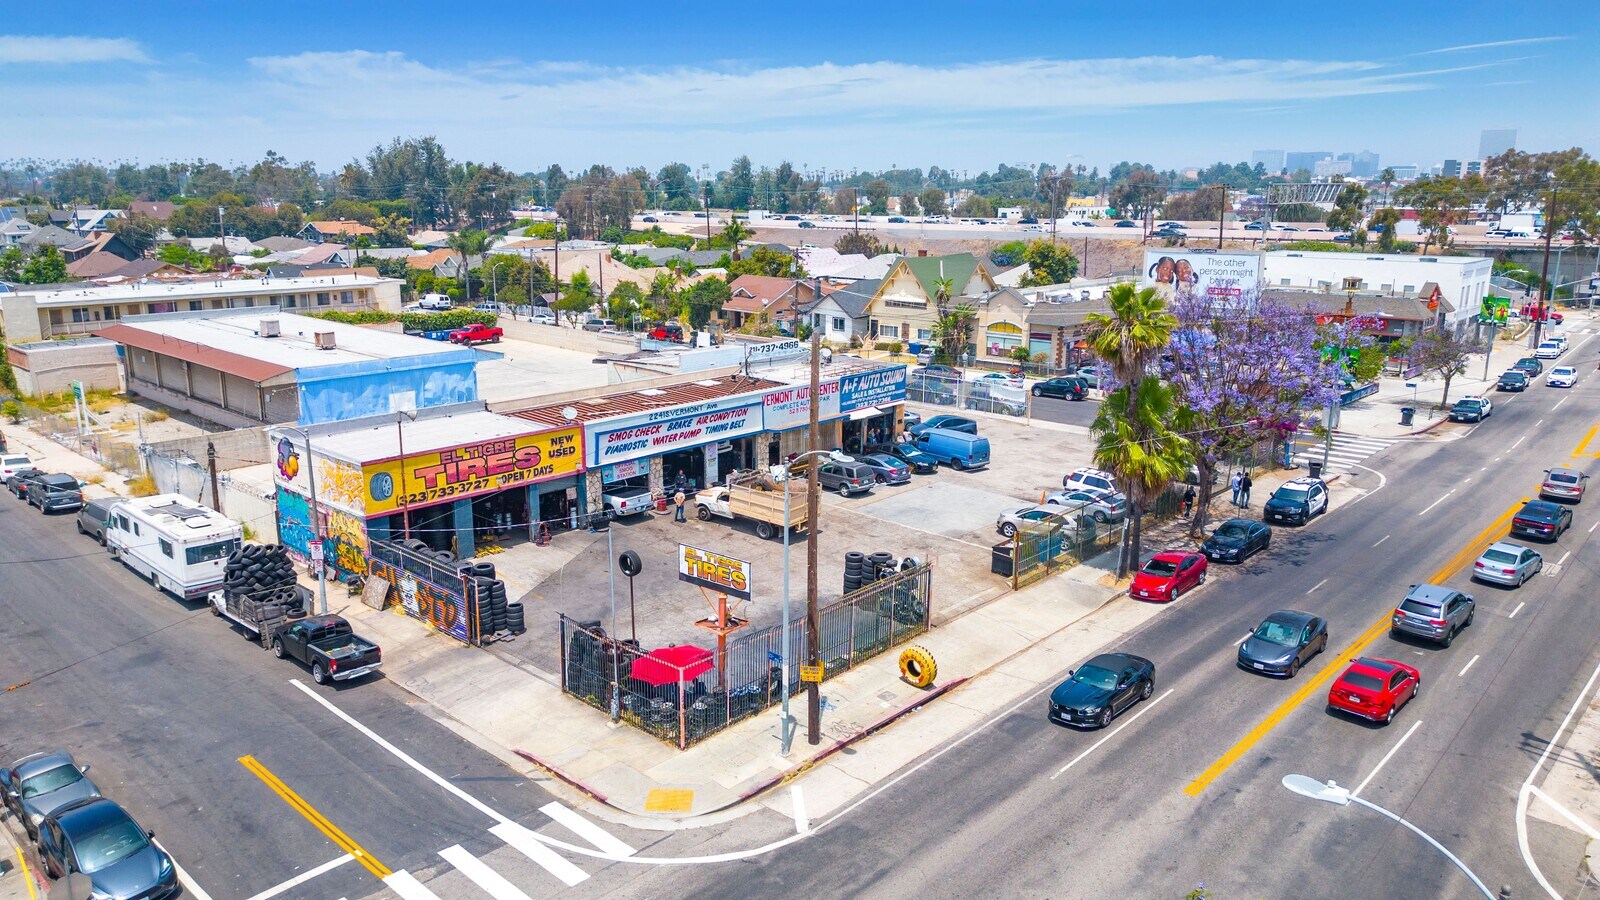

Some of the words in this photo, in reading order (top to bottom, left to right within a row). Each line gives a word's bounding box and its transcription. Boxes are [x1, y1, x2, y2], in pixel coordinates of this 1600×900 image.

[1200, 268, 1228, 277] person
[1230, 269, 1253, 278] might
[1208, 258, 1222, 266] The
[1224, 259, 1246, 267] other
[842, 378, 859, 394] A&F
[858, 374, 880, 390] AUTO
[881, 368, 905, 384] SOUND
[762, 389, 793, 406] VERMONT
[820, 382, 839, 394] ENTER
[772, 401, 799, 411] COMPLETE
[800, 399, 811, 407] AUT
[608, 430, 633, 443] SMOG
[634, 424, 663, 437] CHECK
[667, 418, 694, 432] BRAKE
[696, 414, 709, 426] AIR
[709, 408, 749, 424] CONDITION
[550, 434, 574, 446] NEW
[605, 439, 649, 456] DIAGNOSTIC
[652, 434, 678, 446] WATER
[678, 428, 701, 440] PUMP
[705, 423, 730, 435] TIMING
[729, 418, 746, 430] BELT
[440, 451, 463, 464] EL
[467, 440, 516, 456] TIGRE
[548, 445, 576, 458] USED
[415, 446, 541, 489] TIRES
[501, 474, 526, 484] OPEN
[526, 470, 532, 479] 7
[533, 465, 554, 476] DAYS
[705, 552, 742, 571] TIGRE
[685, 557, 747, 590] TIRES
